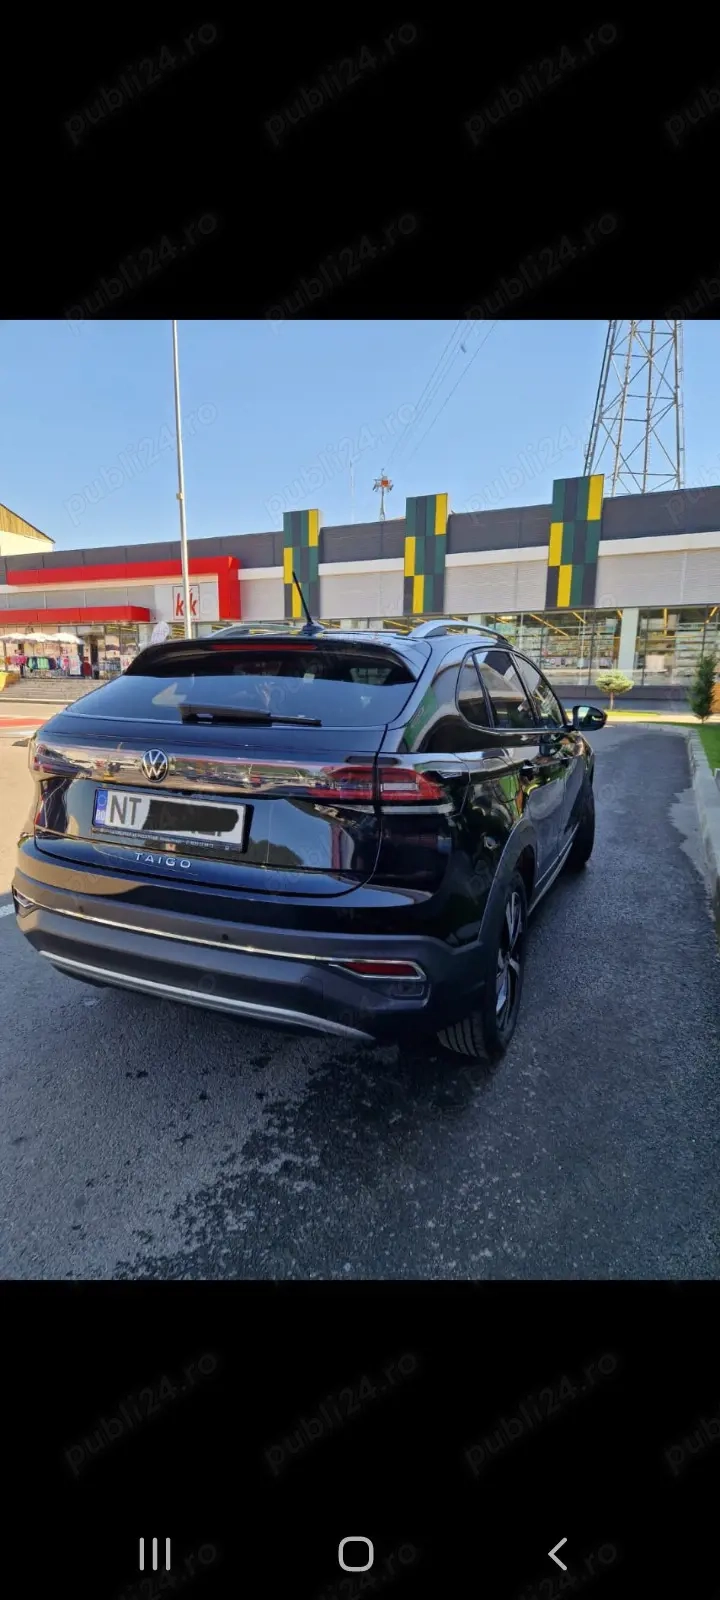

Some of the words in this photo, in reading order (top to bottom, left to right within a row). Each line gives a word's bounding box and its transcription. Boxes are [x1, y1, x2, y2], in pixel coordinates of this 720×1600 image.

[175, 588, 197, 616] kk
[110, 794, 142, 826] NT
[135, 852, 191, 868] TAIGO
